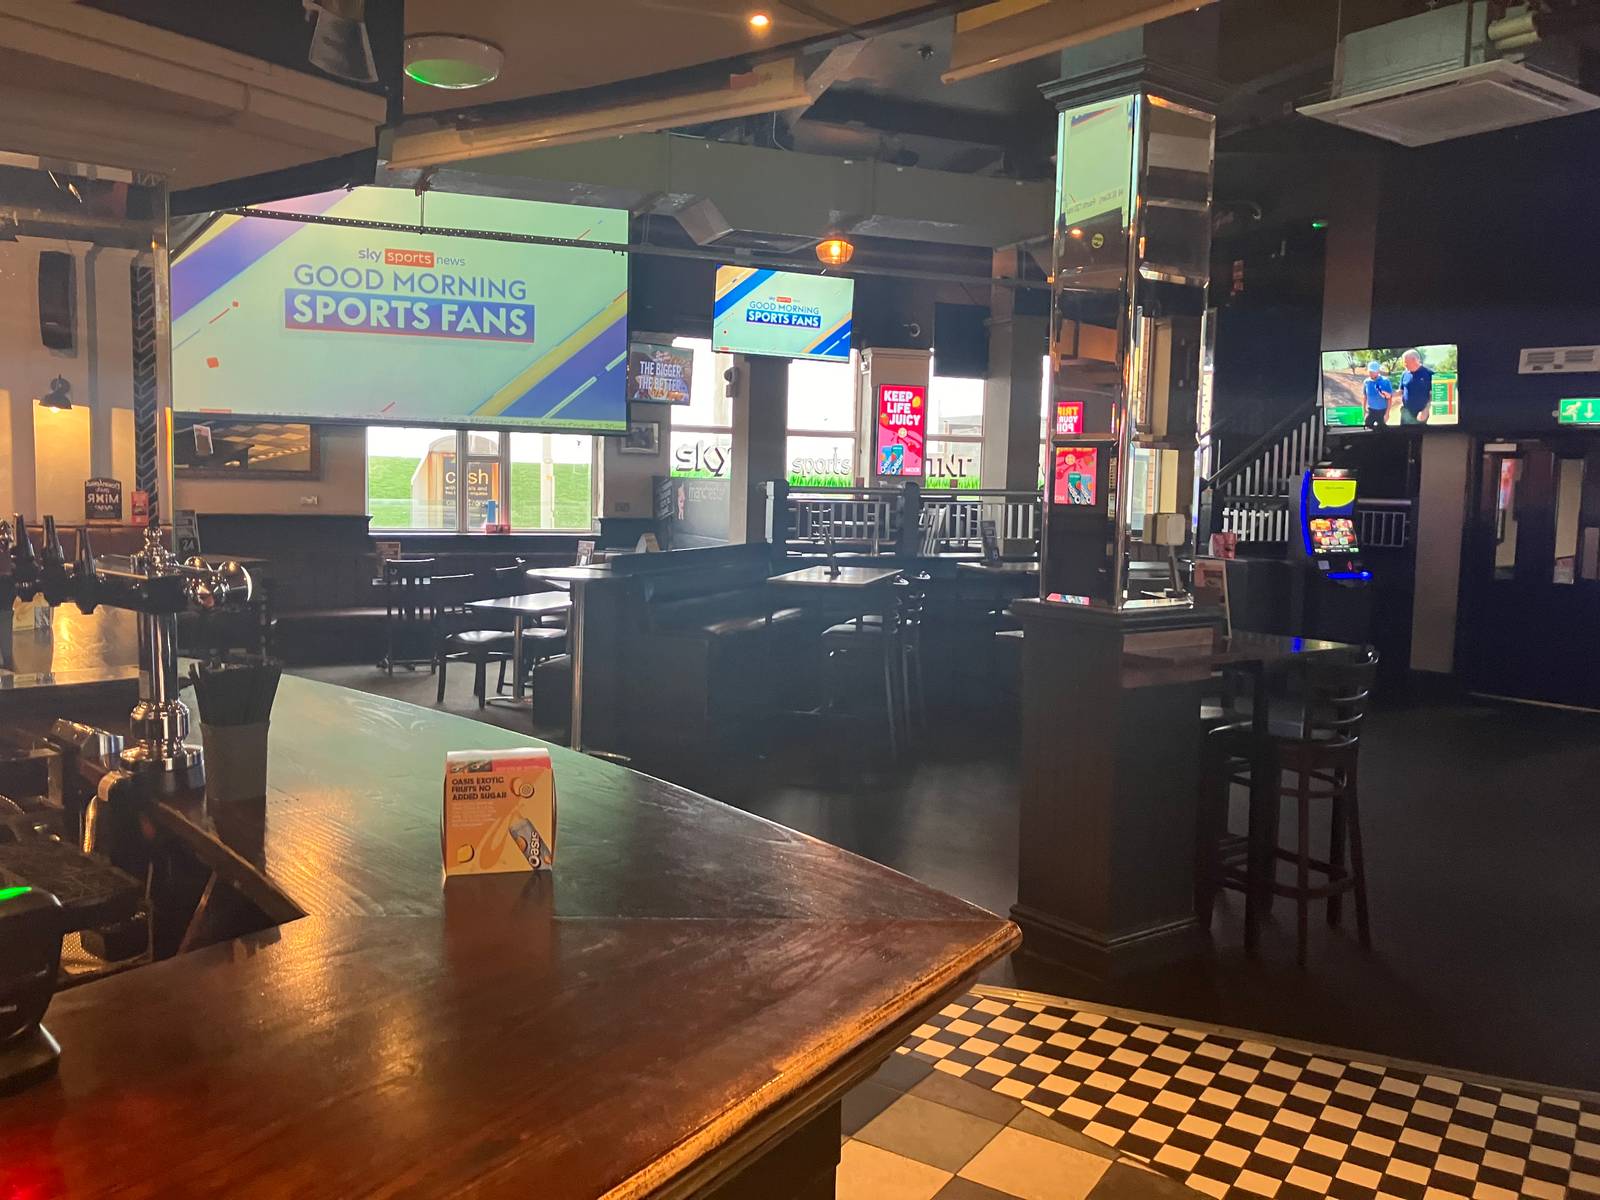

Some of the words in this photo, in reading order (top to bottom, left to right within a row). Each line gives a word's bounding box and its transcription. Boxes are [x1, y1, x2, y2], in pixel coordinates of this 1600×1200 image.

[358, 247, 382, 263] sky
[386, 250, 432, 265] sports
[436, 256, 466, 266] news
[293, 263, 385, 290] GOOD
[393, 270, 528, 301] MORNING
[293, 293, 431, 330] SPORTS
[441, 303, 528, 336] FANS
[749, 300, 777, 311] GOOD
[778, 304, 820, 315] MORNING
[748, 310, 790, 324] SPORTS
[791, 314, 819, 327] FANS
[640, 360, 655, 375] THE
[637, 375, 654, 390] THE
[883, 390, 914, 402] KEEP
[886, 402, 911, 414] LIFE
[889, 414, 921, 426] JUICY
[792, 446, 851, 478] sports
[445, 468, 489, 485] csh
[451, 778, 475, 786] OASIS
[476, 776, 504, 785] EXOTIC
[478, 784, 492, 792] NO
[452, 793, 479, 801] ADDED
[480, 791, 507, 800] SUGAR
[528, 831, 541, 868] Oasis
